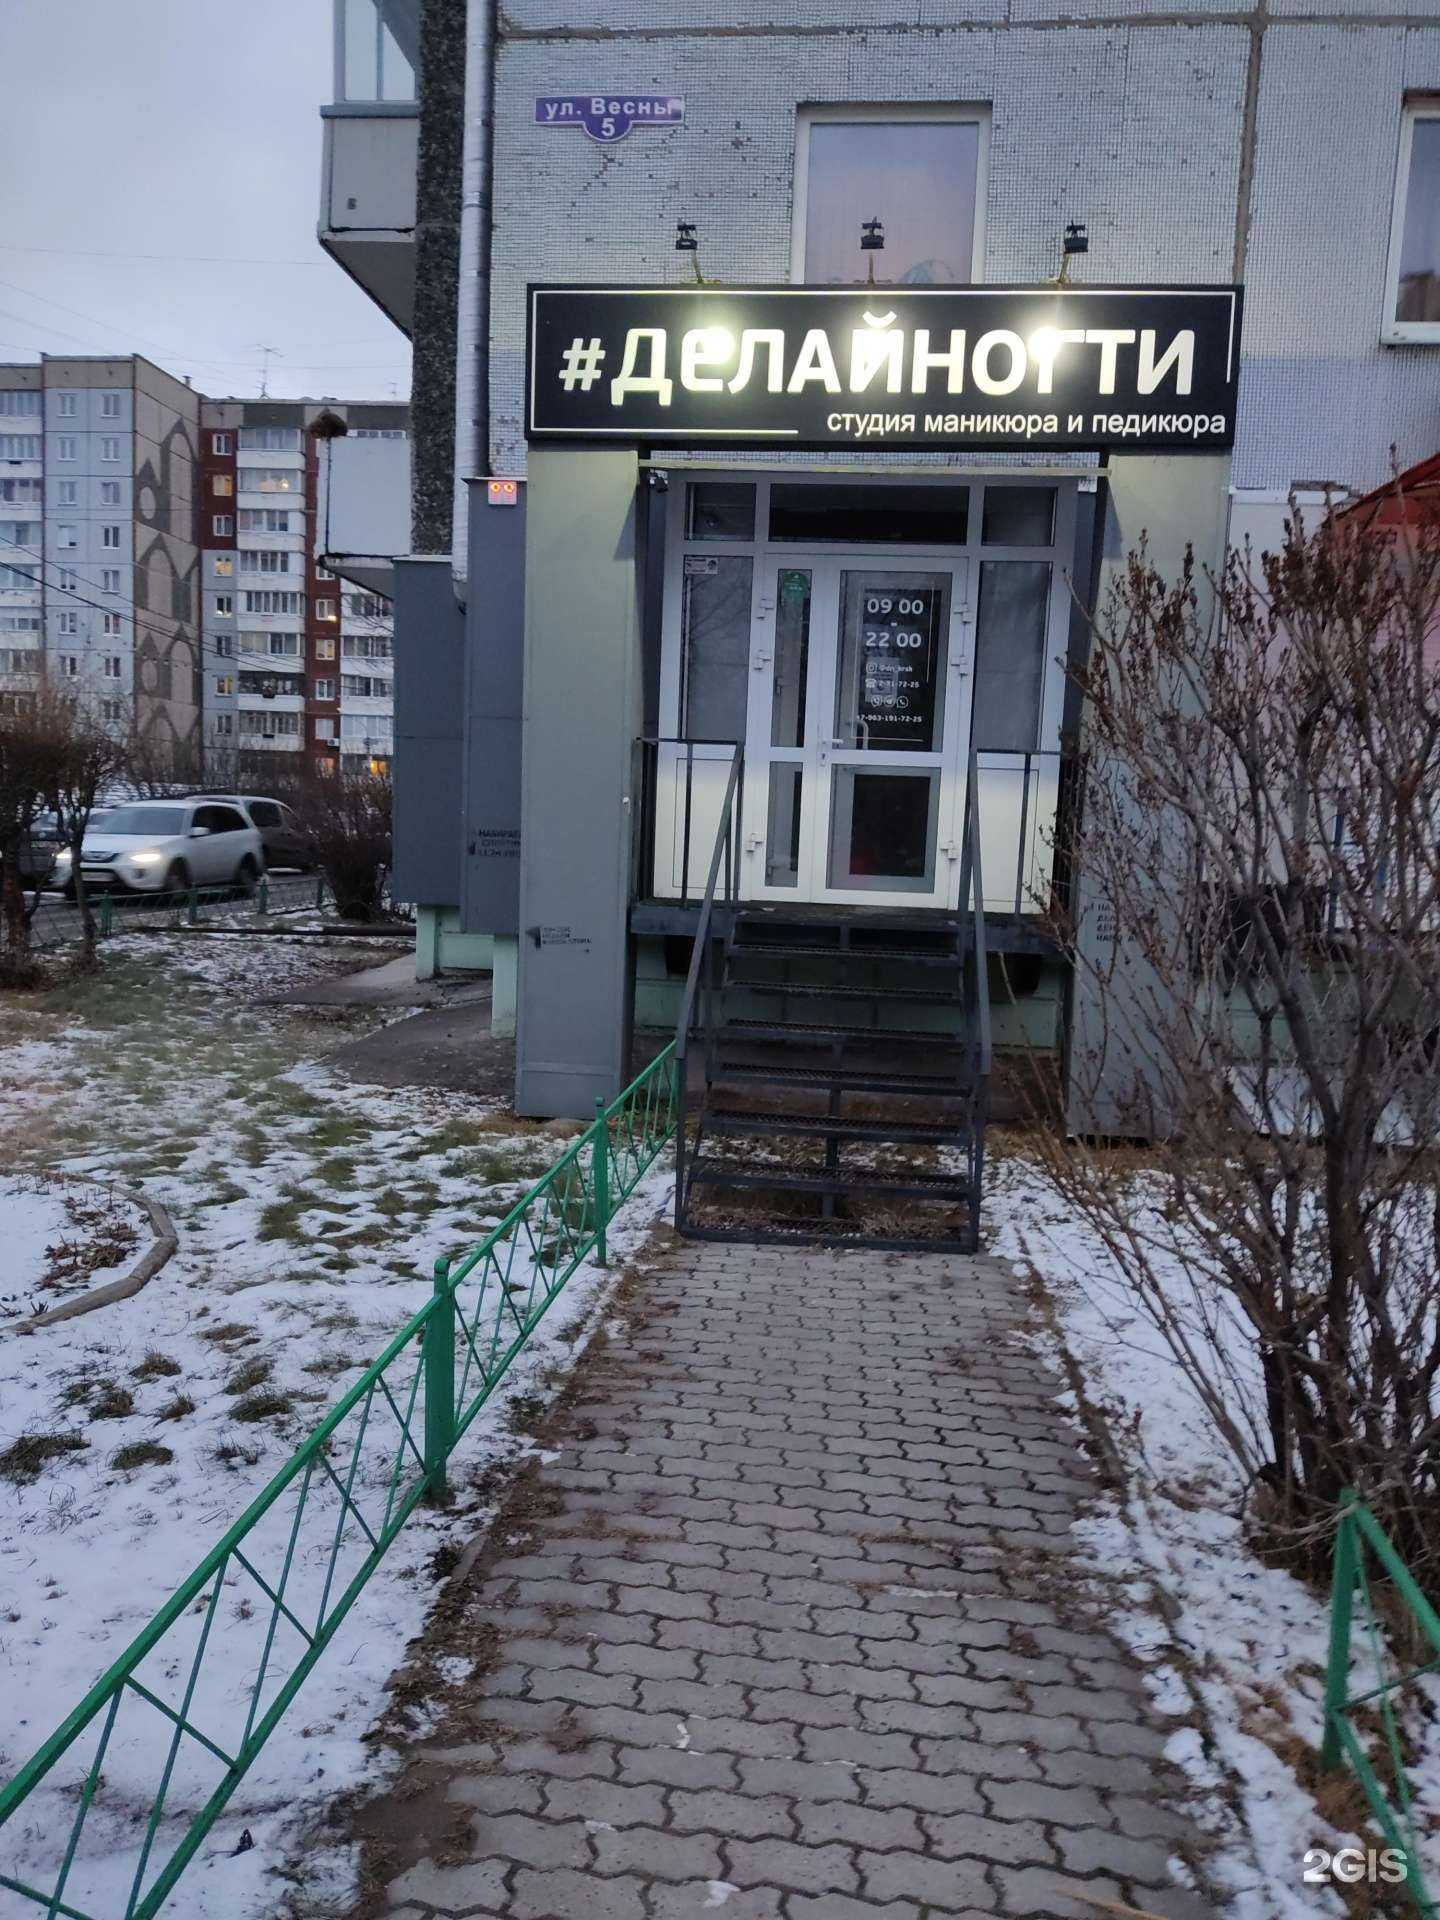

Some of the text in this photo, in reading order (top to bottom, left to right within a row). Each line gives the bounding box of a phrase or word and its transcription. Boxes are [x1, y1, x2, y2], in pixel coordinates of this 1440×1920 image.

[545, 97, 672, 120] ул. Весны
[601, 117, 615, 137] 5
[827, 413, 1227, 436] студия маникюра и педикюра
